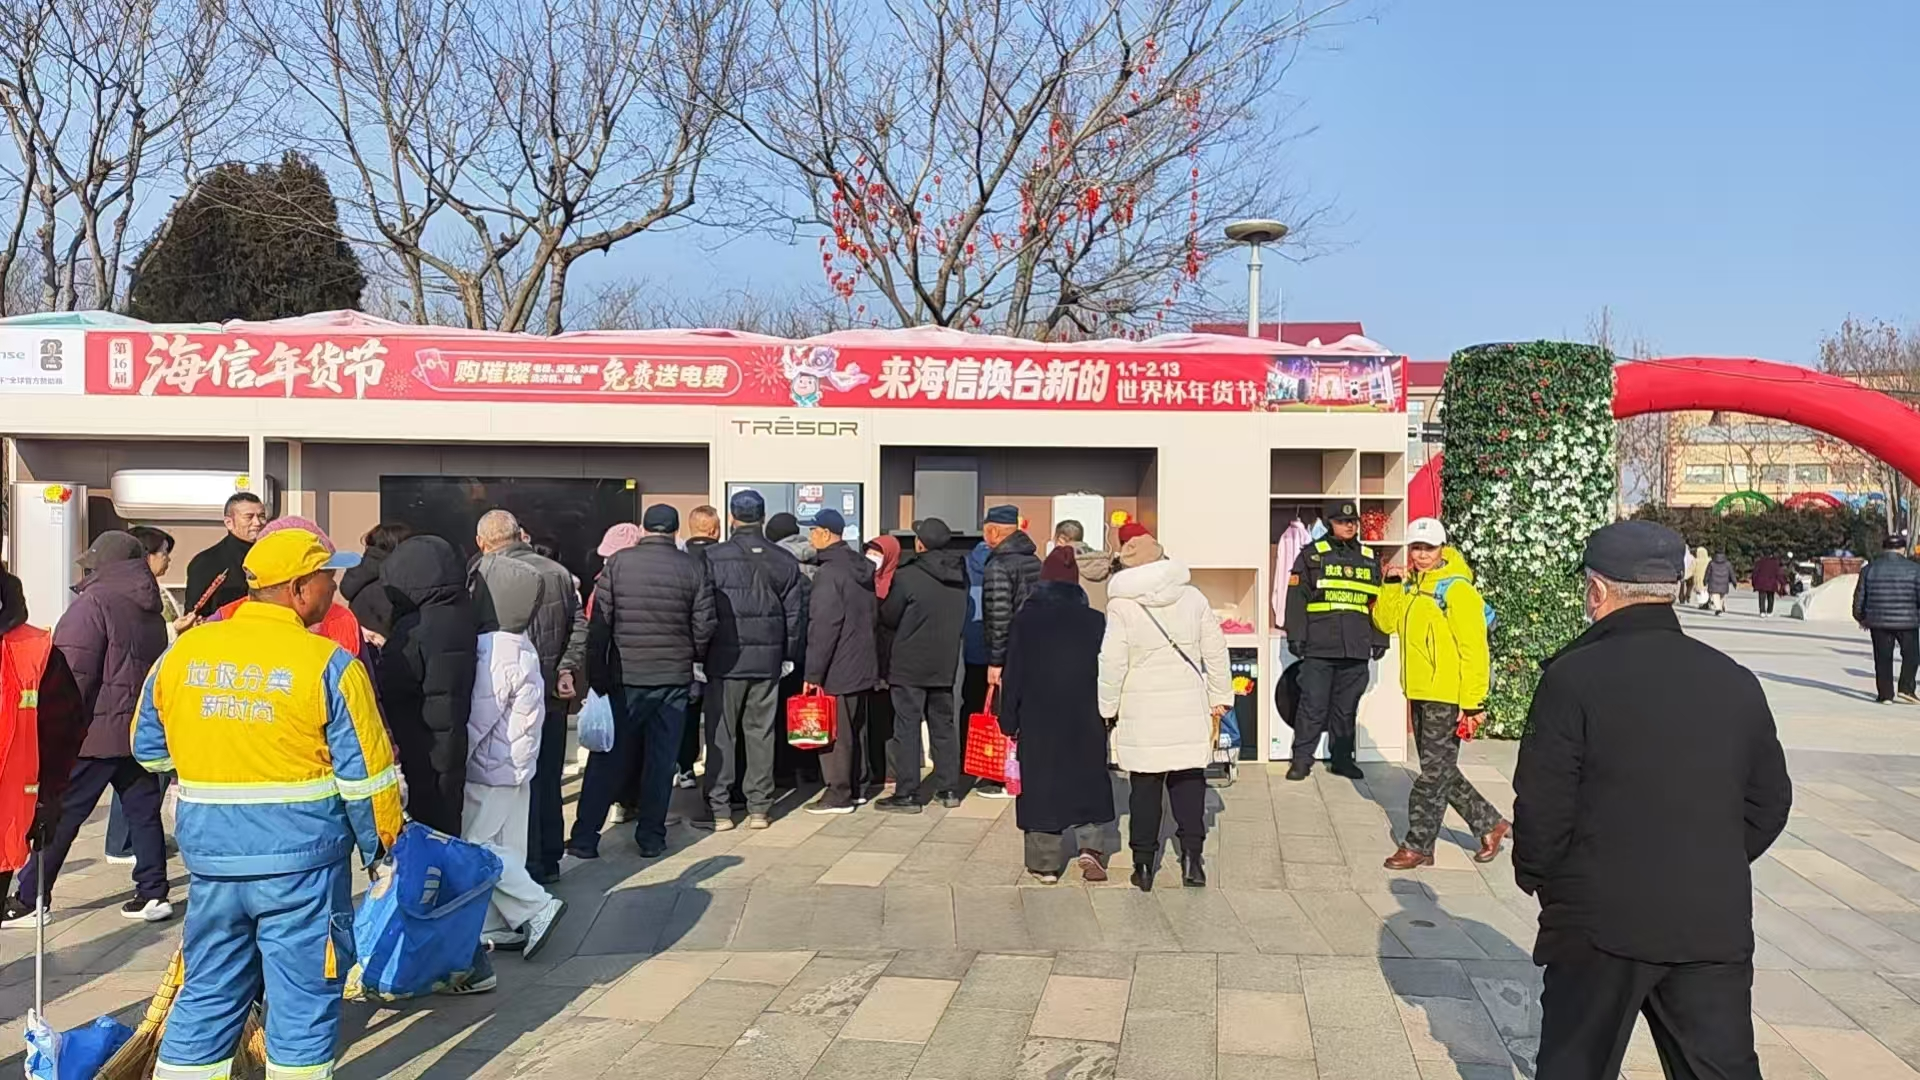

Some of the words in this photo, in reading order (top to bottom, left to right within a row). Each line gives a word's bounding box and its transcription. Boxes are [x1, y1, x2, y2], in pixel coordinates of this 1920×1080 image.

[139, 334, 388, 399] 海信年货节
[454, 360, 532, 384] 购璀璨
[599, 356, 728, 391] 免费送电费
[869, 355, 1110, 403] 来海信换台新的
[1116, 361, 1180, 377] 1.1-2.13
[1115, 379, 1257, 405] 世界杯年货节
[184, 660, 293, 695] 垃圾分类
[201, 694, 274, 723] 新时尚
